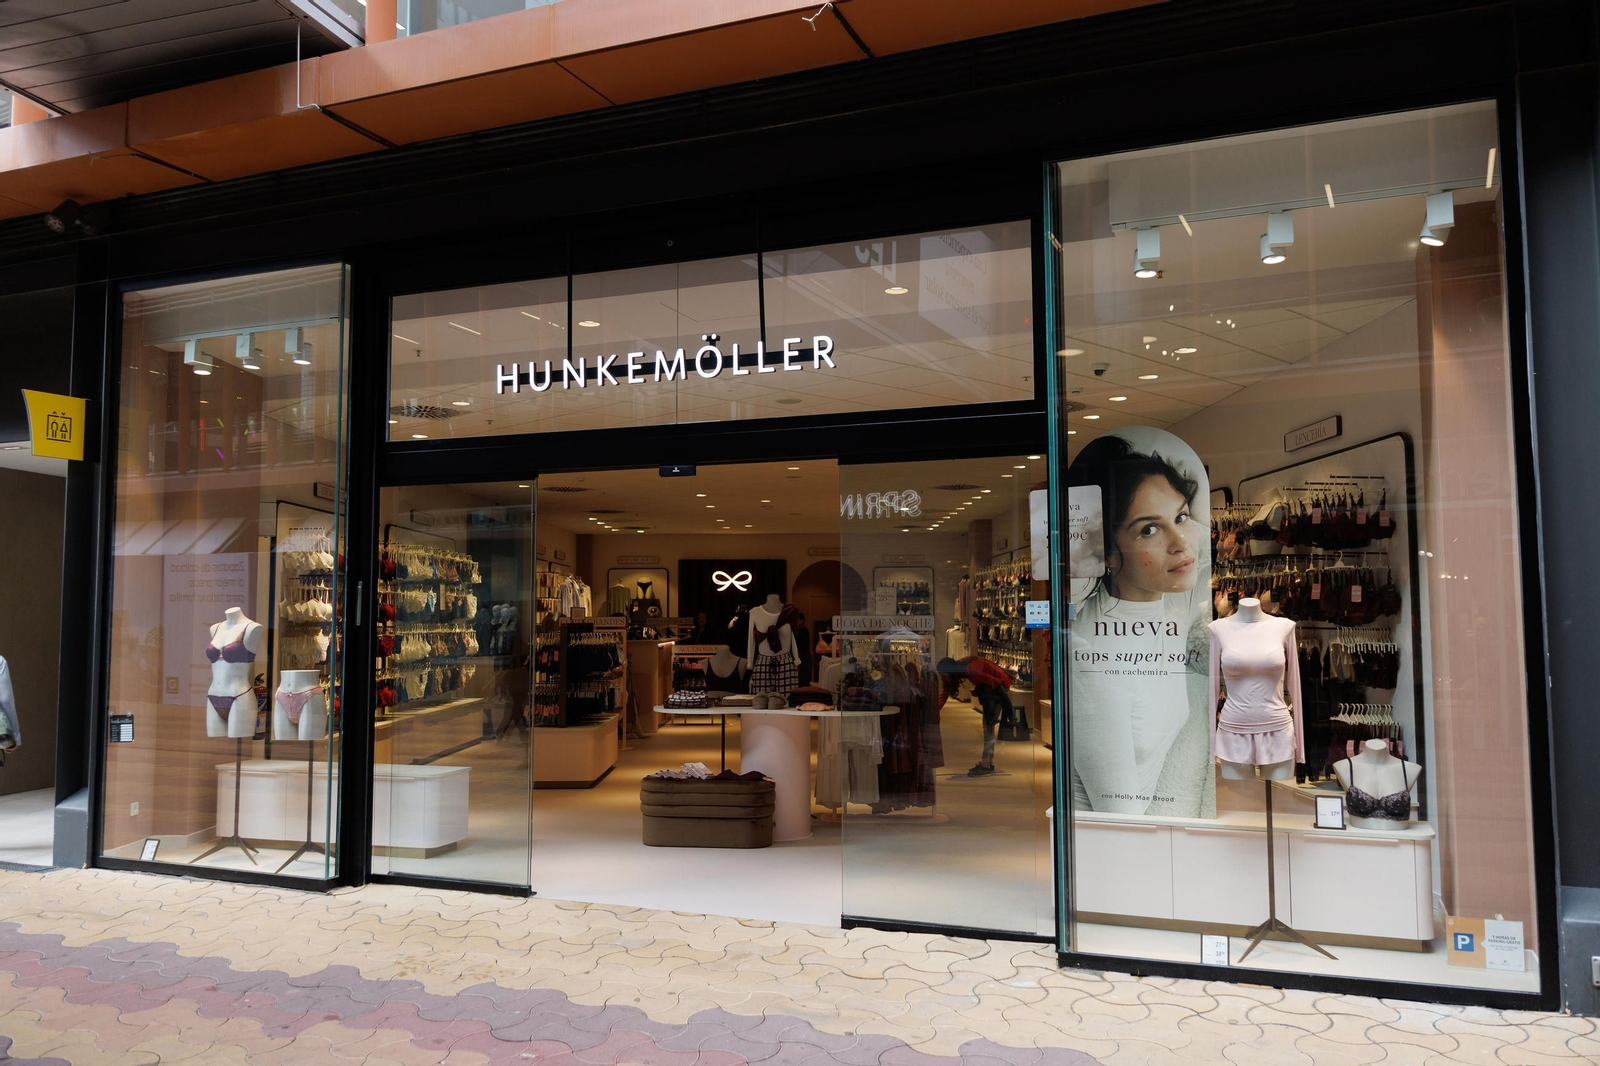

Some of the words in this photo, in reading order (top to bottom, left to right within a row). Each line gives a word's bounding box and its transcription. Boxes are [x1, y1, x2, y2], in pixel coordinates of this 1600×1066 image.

[497, 333, 837, 395] HUNKEMÖLLER
[869, 618, 886, 628] DE
[889, 618, 932, 628] NOCHE
[1093, 620, 1180, 637] nueva
[1074, 650, 1110, 664] tops
[1115, 651, 1163, 665] super
[1168, 649, 1202, 666] soft
[1122, 668, 1169, 676] cachemira
[1114, 793, 1134, 801] Holly
[1152, 795, 1175, 803] Brood
[1457, 934, 1470, 950] P
